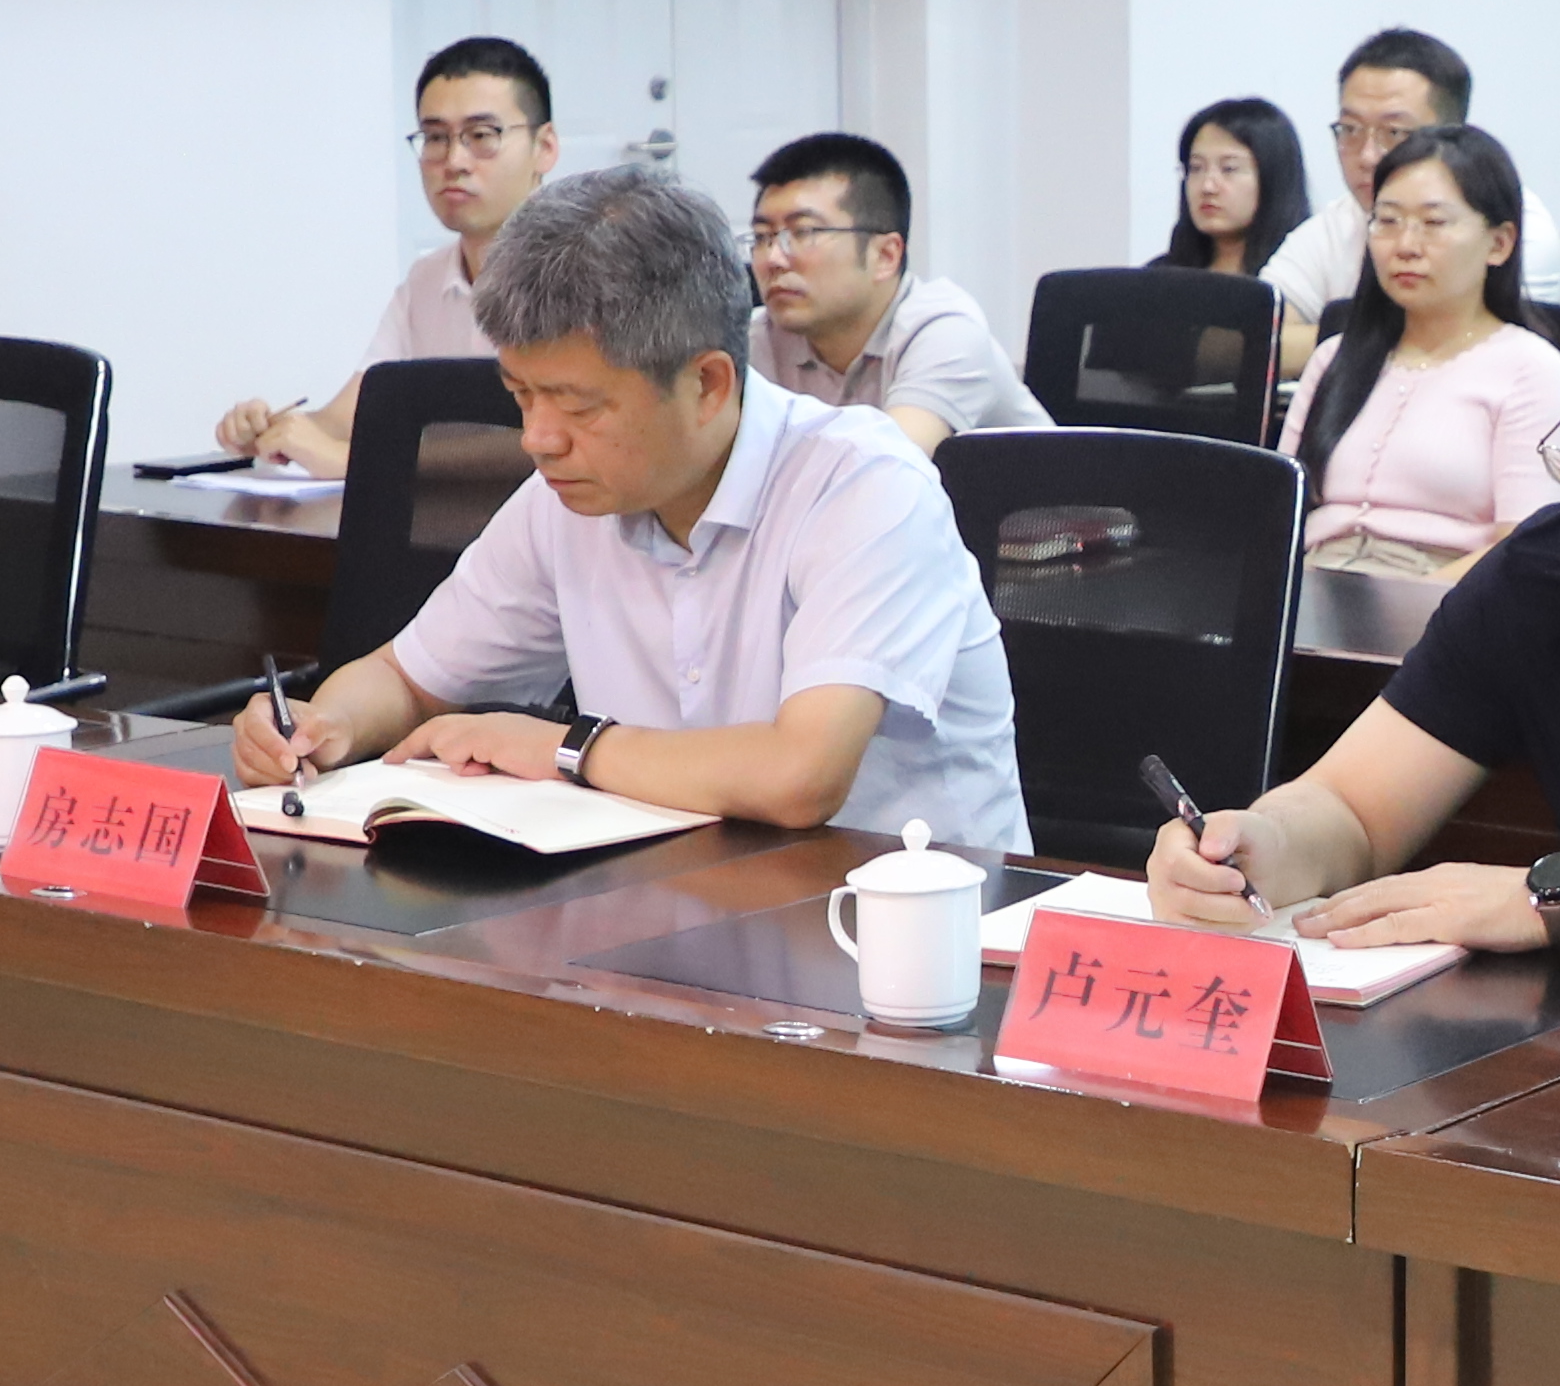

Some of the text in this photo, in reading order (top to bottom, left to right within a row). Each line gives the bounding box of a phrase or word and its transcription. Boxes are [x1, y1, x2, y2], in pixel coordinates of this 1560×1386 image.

[27, 785, 192, 868] 房志国
[1028, 951, 1253, 1056] 卢元奎
